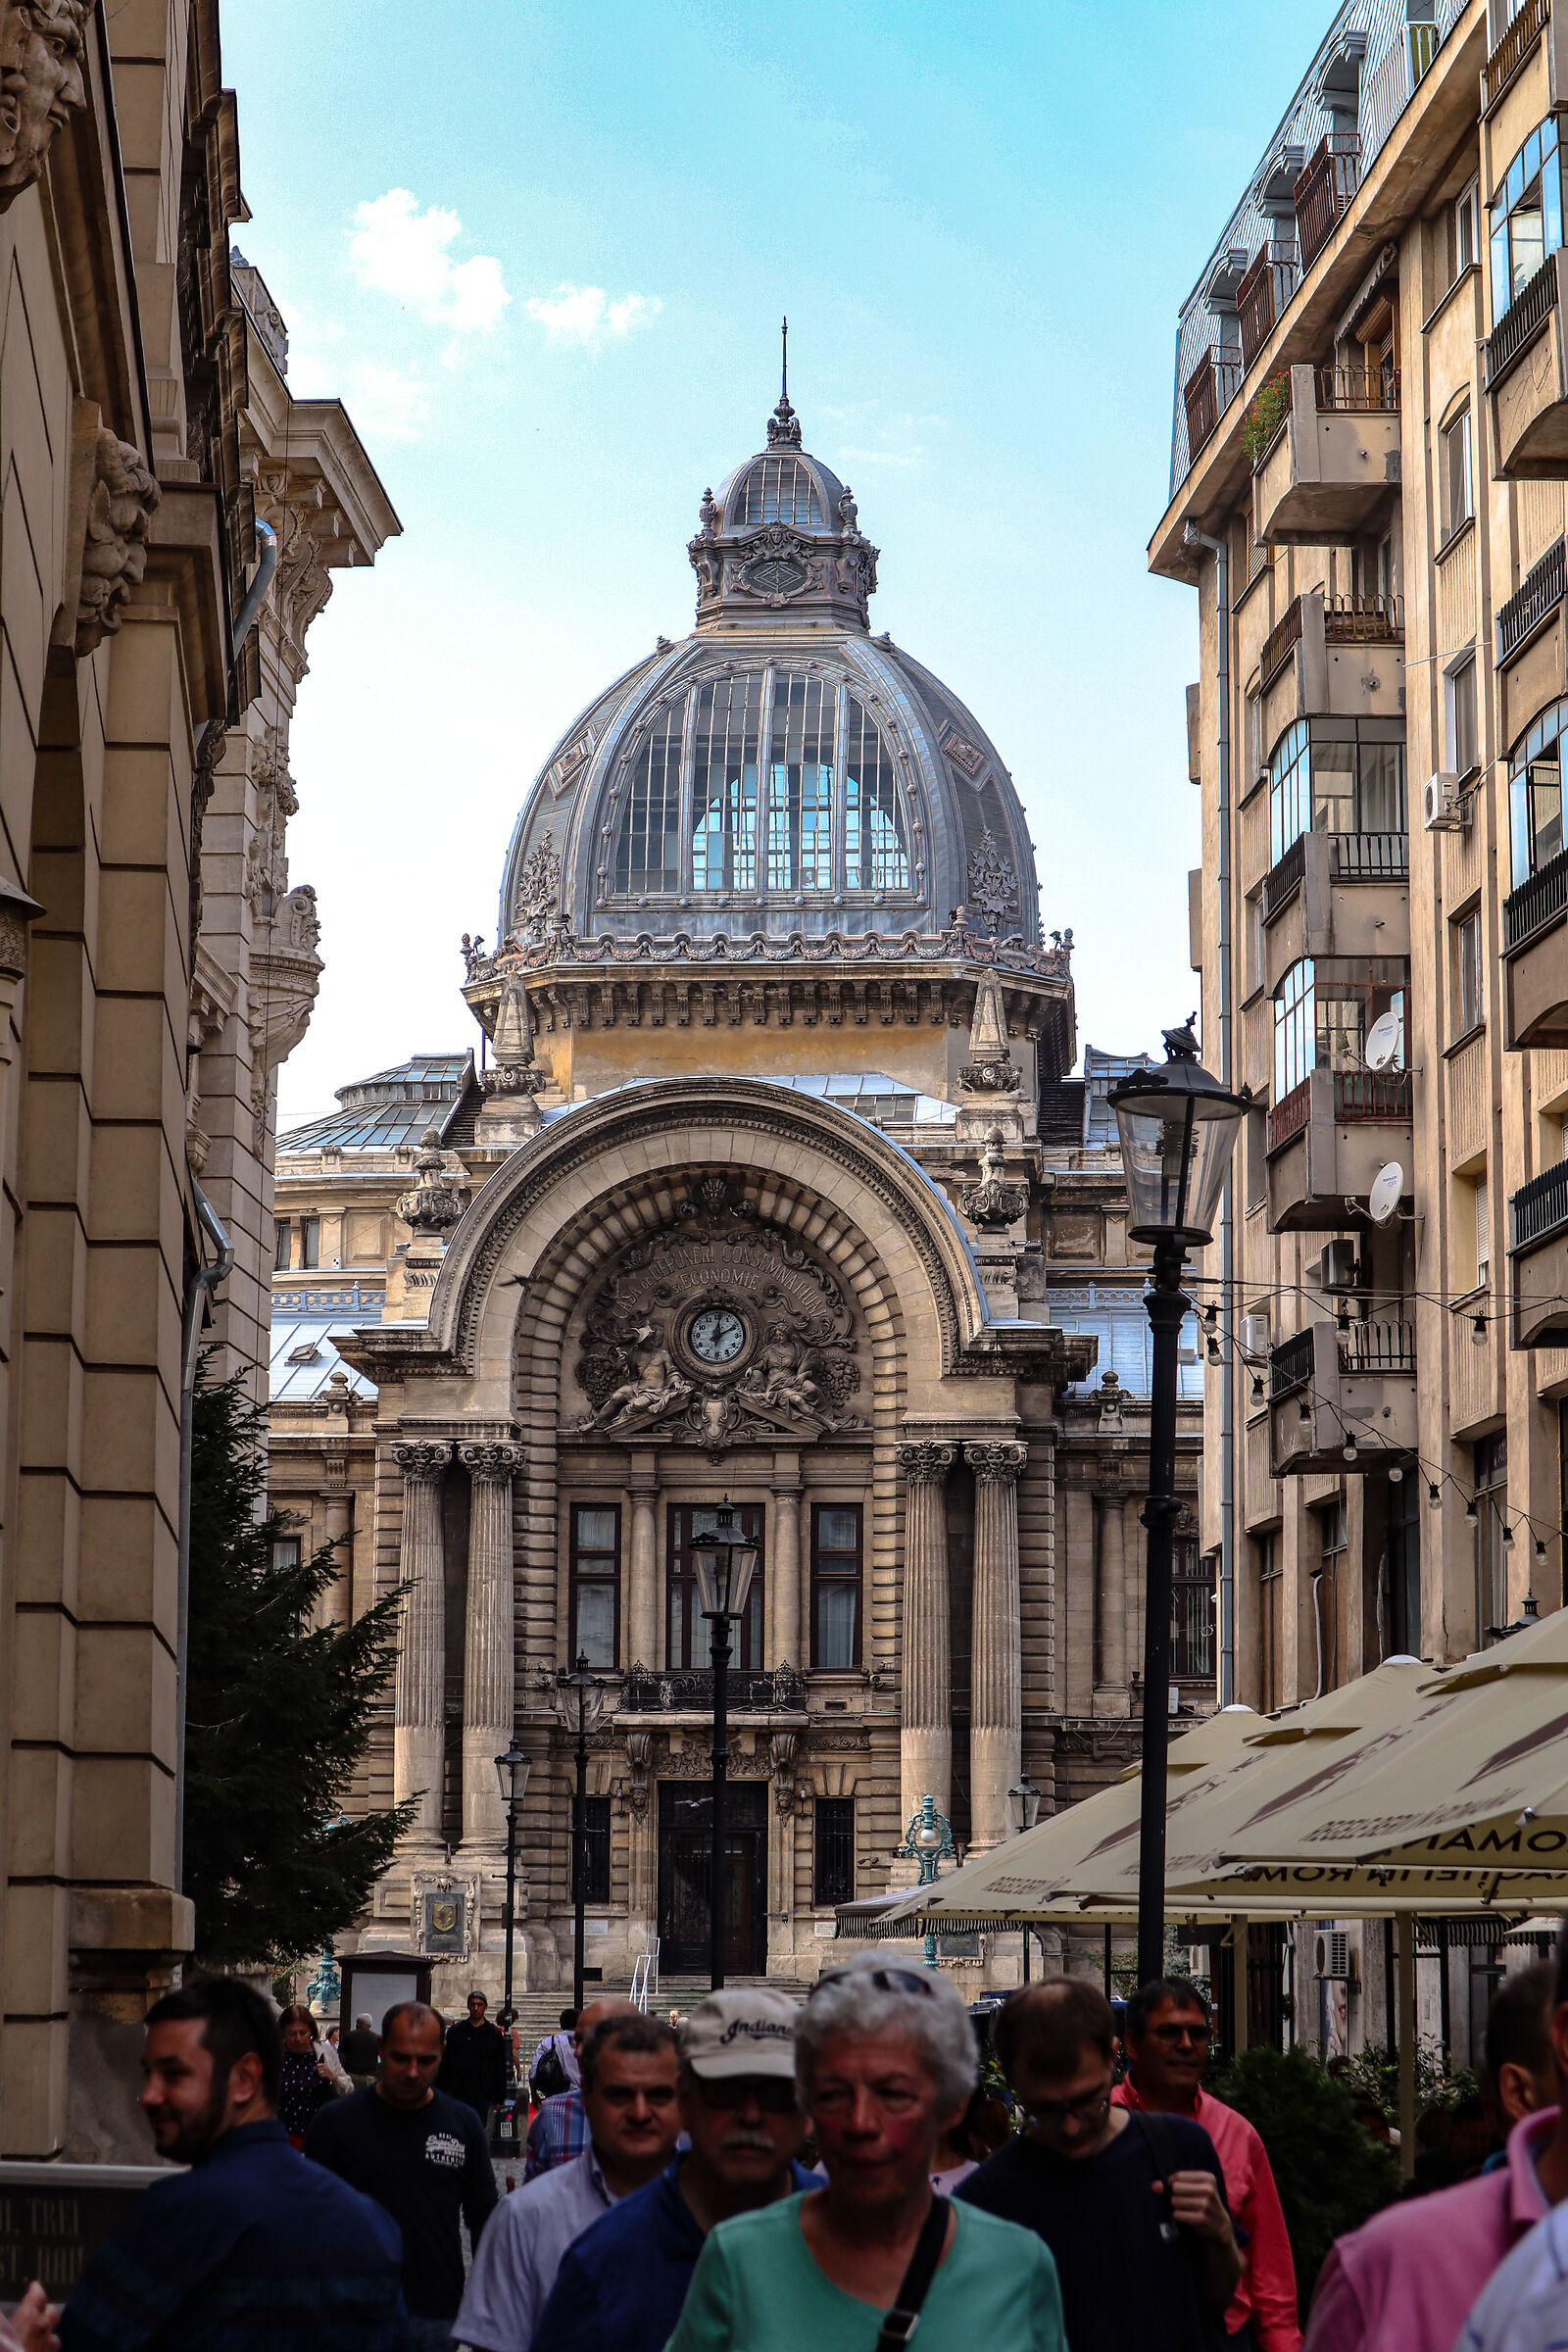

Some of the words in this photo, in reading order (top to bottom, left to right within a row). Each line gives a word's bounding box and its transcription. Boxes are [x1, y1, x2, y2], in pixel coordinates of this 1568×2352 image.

[612, 1285, 642, 1319] CASA
[640, 1277, 654, 1291] DE
[648, 1246, 714, 1282] DEPUNERI
[680, 1268, 760, 1291] ECONOMIE
